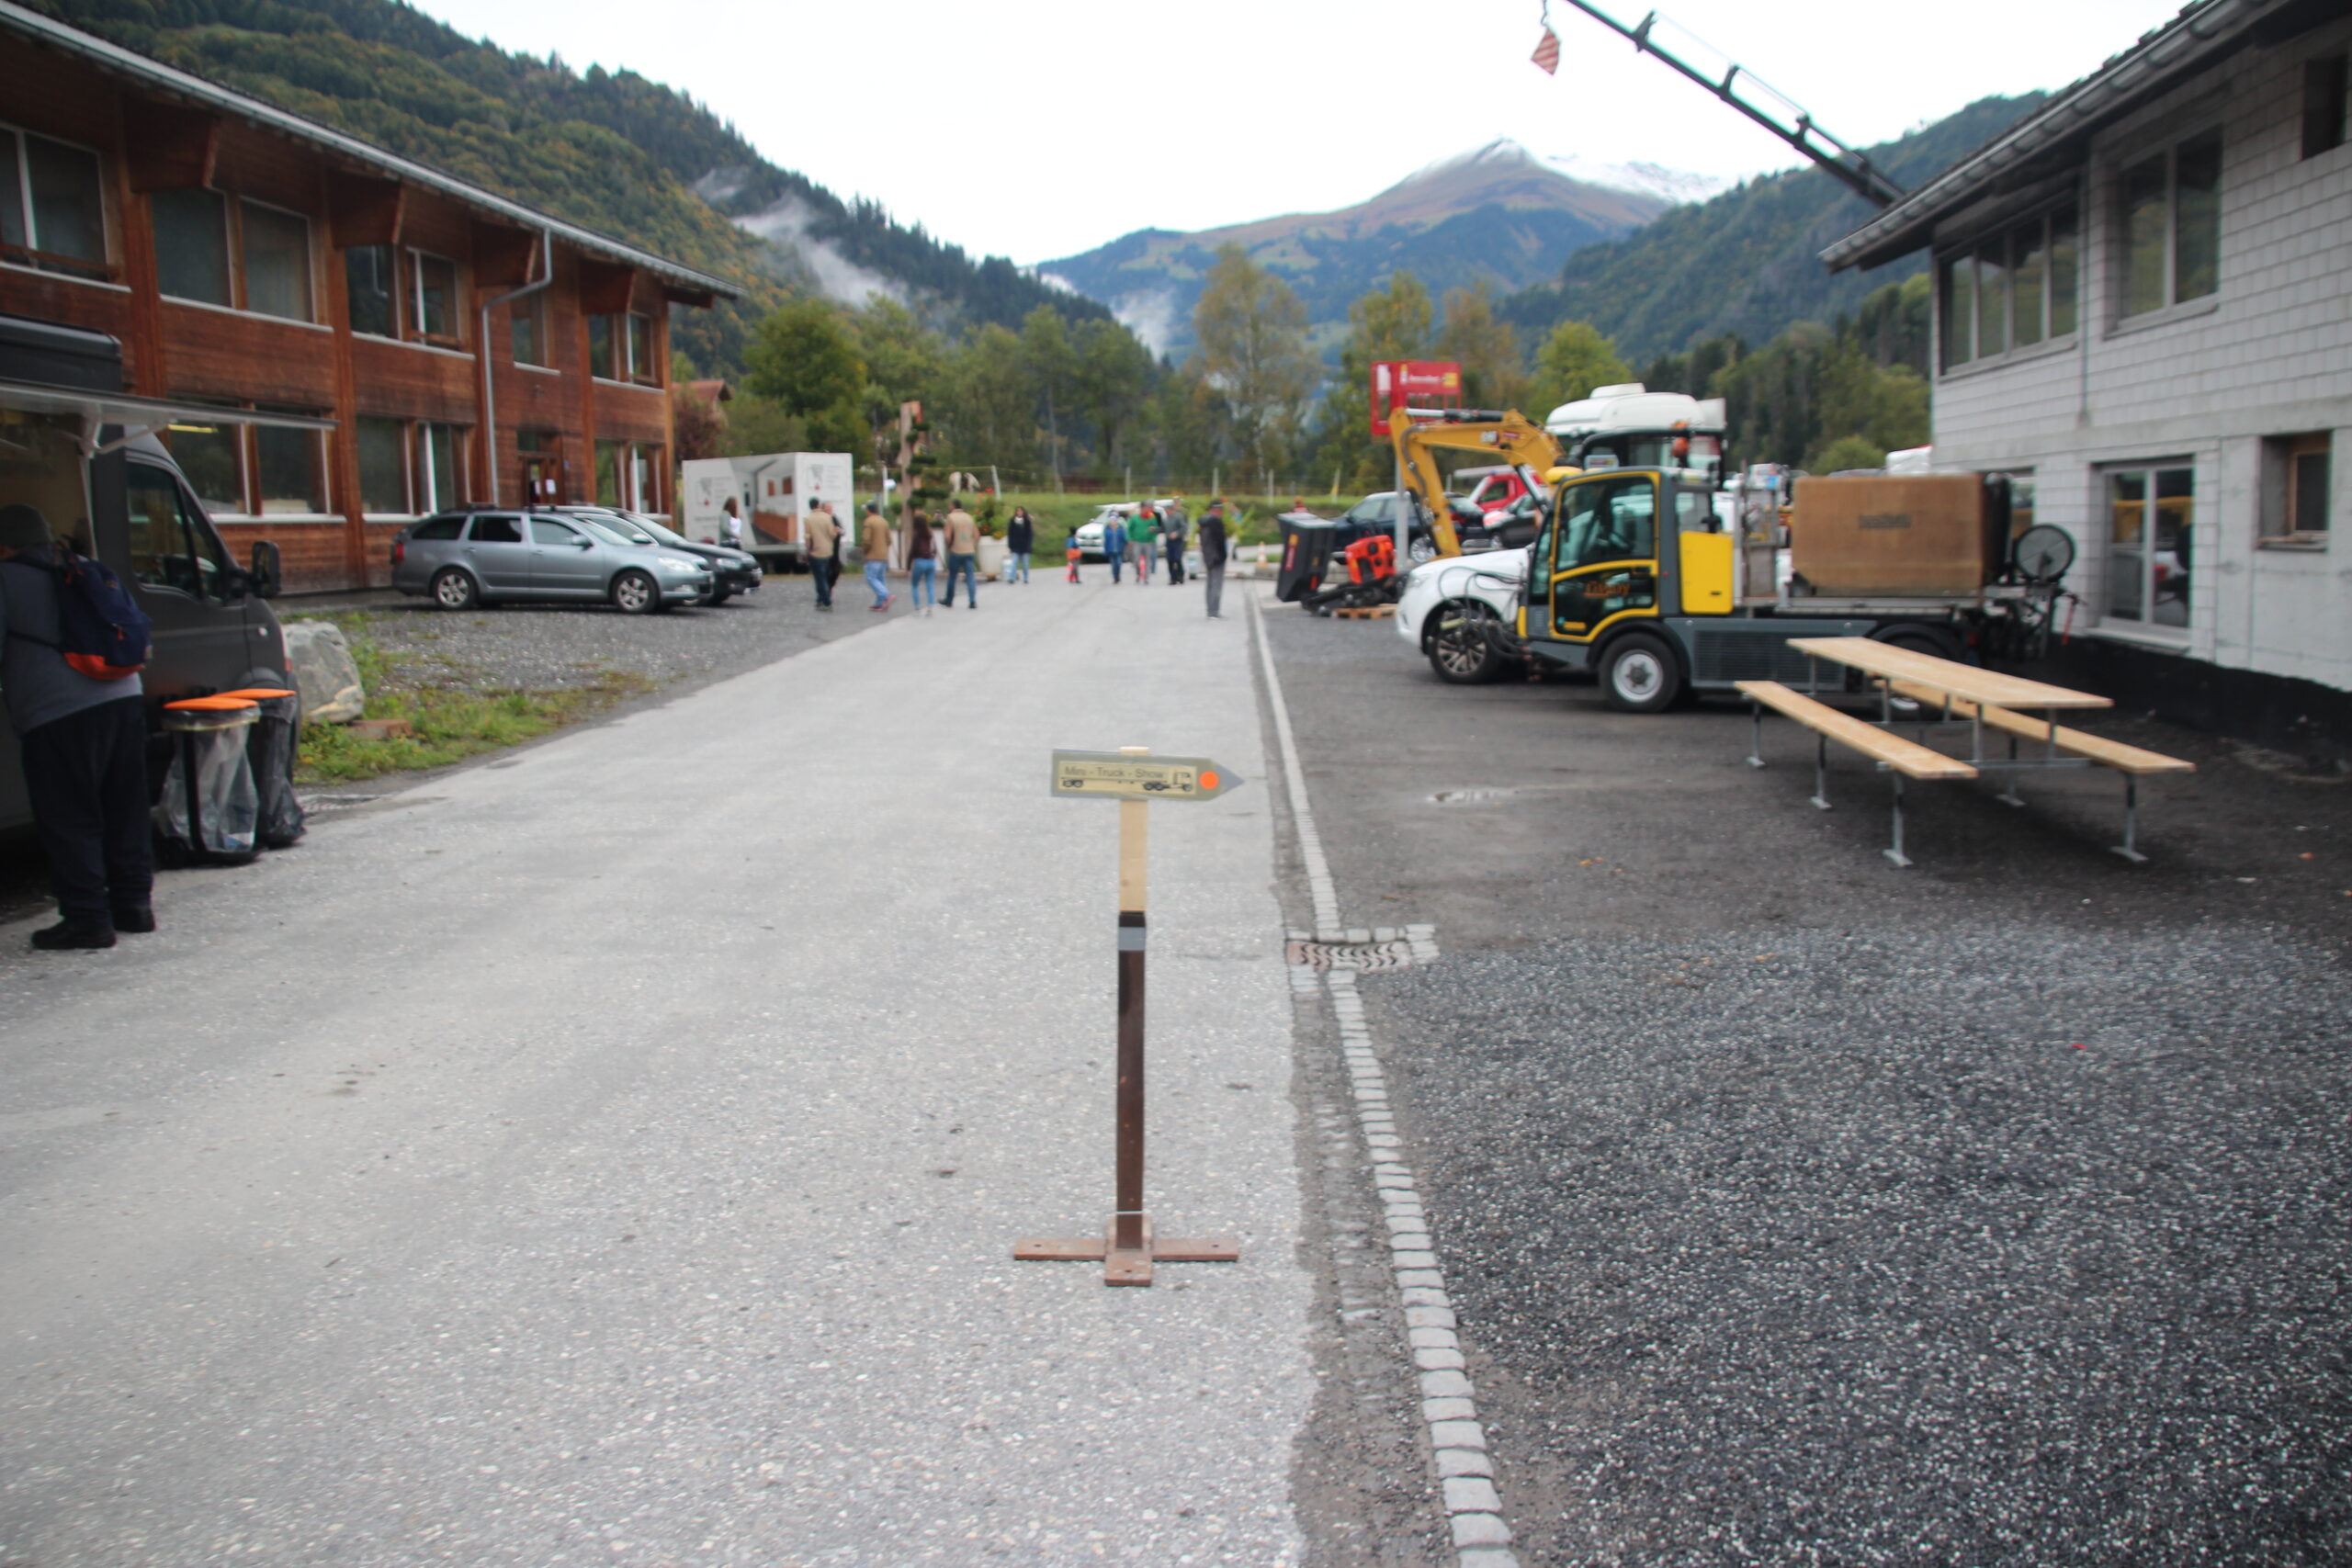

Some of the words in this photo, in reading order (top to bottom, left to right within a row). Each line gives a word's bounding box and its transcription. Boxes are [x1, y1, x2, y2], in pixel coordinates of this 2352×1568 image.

[1064, 766, 1086, 776] Mini
[1096, 766, 1125, 777] Truck
[1135, 768, 1164, 778] Show
